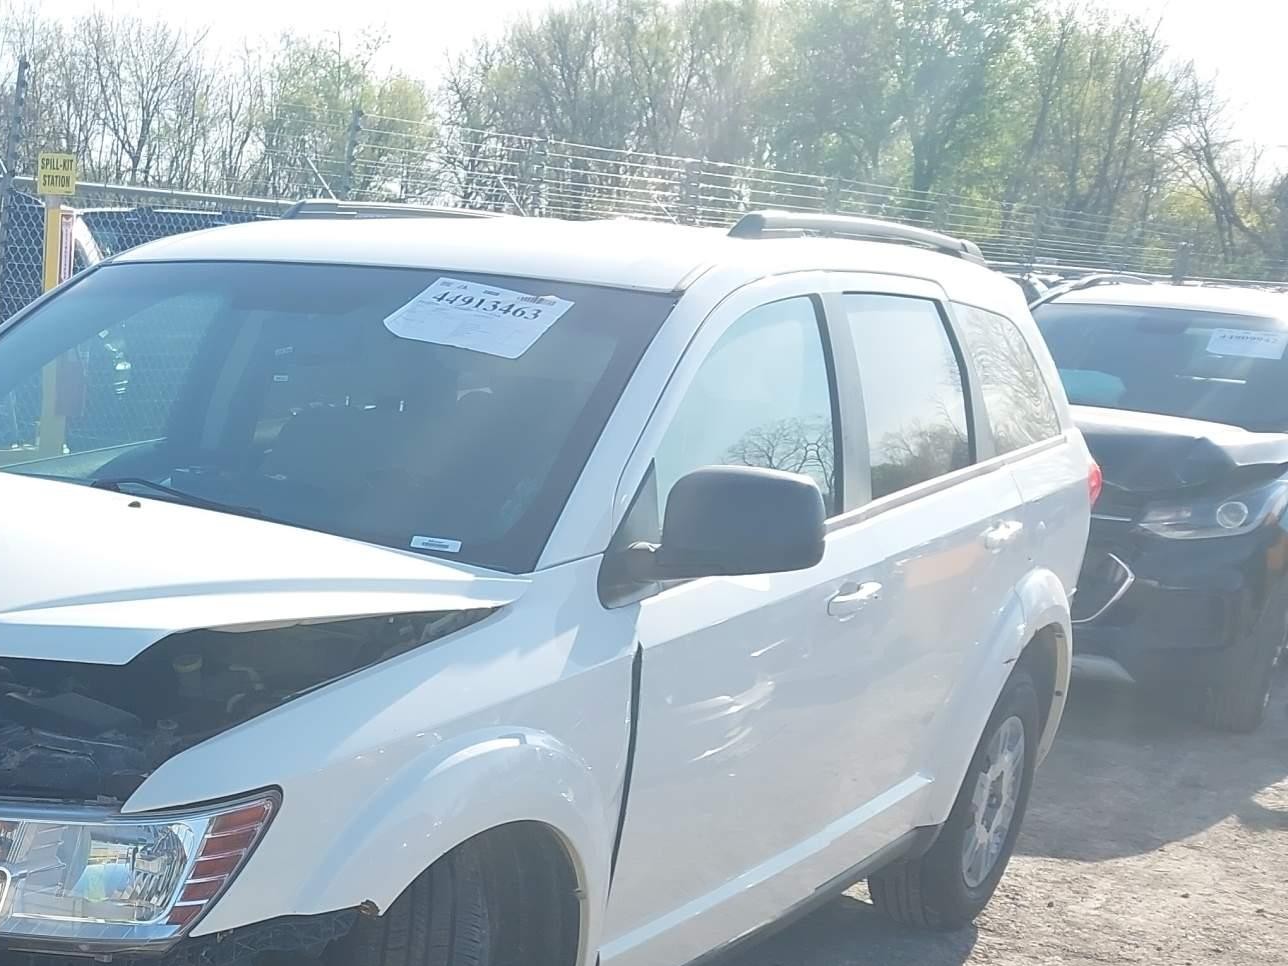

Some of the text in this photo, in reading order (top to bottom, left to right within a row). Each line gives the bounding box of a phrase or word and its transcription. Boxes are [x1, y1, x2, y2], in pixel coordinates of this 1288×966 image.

[41, 158, 74, 171] SPILL-KIT
[42, 174, 71, 188] STATION
[432, 291, 542, 321] 44913463
